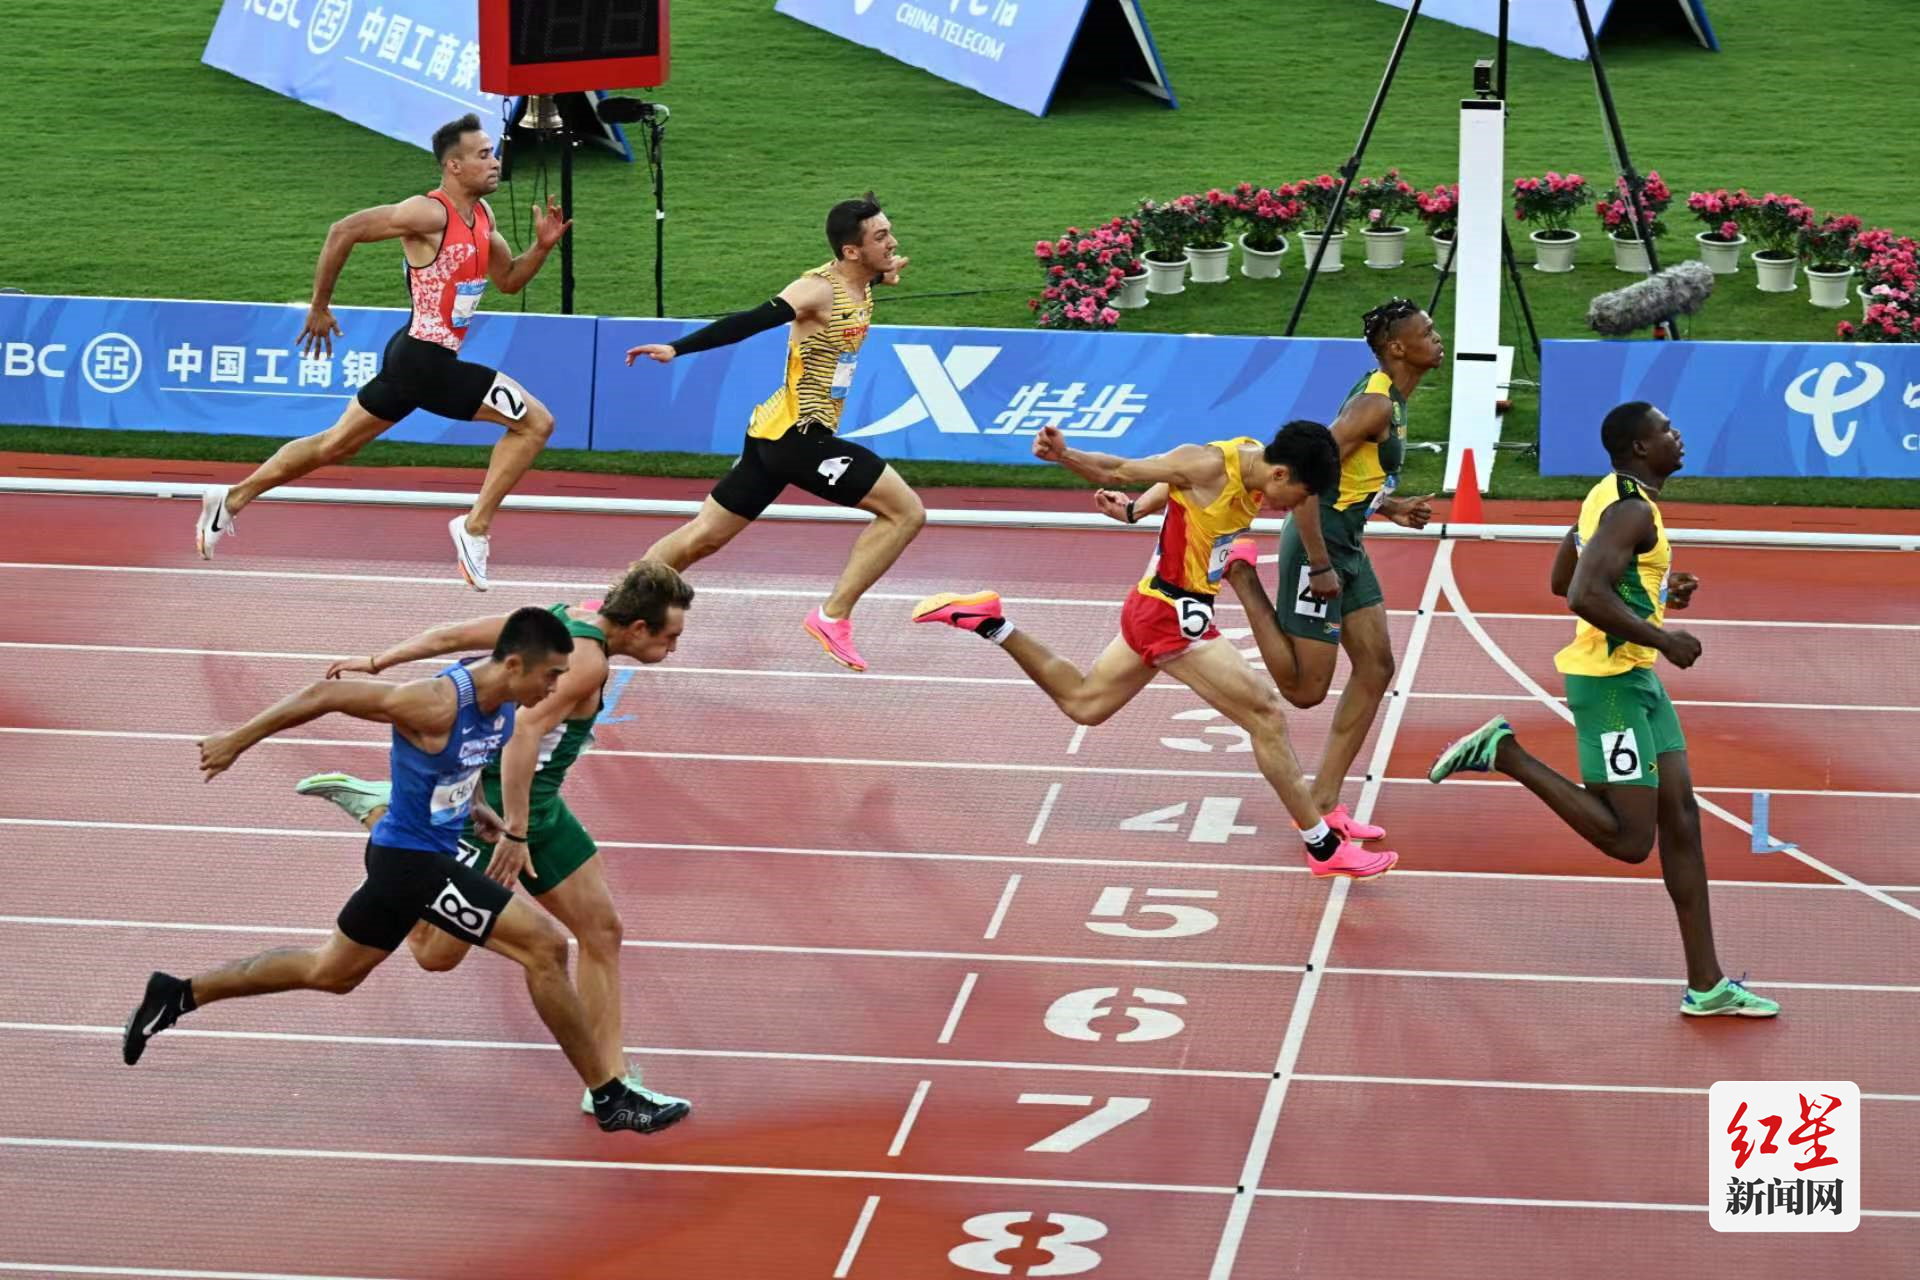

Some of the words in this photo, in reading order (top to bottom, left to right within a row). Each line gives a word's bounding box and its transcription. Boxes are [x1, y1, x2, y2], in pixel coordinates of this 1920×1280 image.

[357, 5, 494, 100] 中国工商银
[896, 2, 940, 35] CHINA
[940, 18, 1006, 61] TELECOM
[0, 342, 67, 378] BC
[490, 386, 524, 416] 2
[984, 382, 1149, 438] 特步
[1182, 600, 1209, 637] 5
[1610, 734, 1638, 776] 6
[1119, 797, 1258, 843] 4
[440, 893, 484, 930] 8
[1084, 886, 1219, 938] 5
[1043, 987, 1188, 1042] 6
[1016, 1093, 1151, 1153] 7
[947, 1211, 1108, 1276] 8
